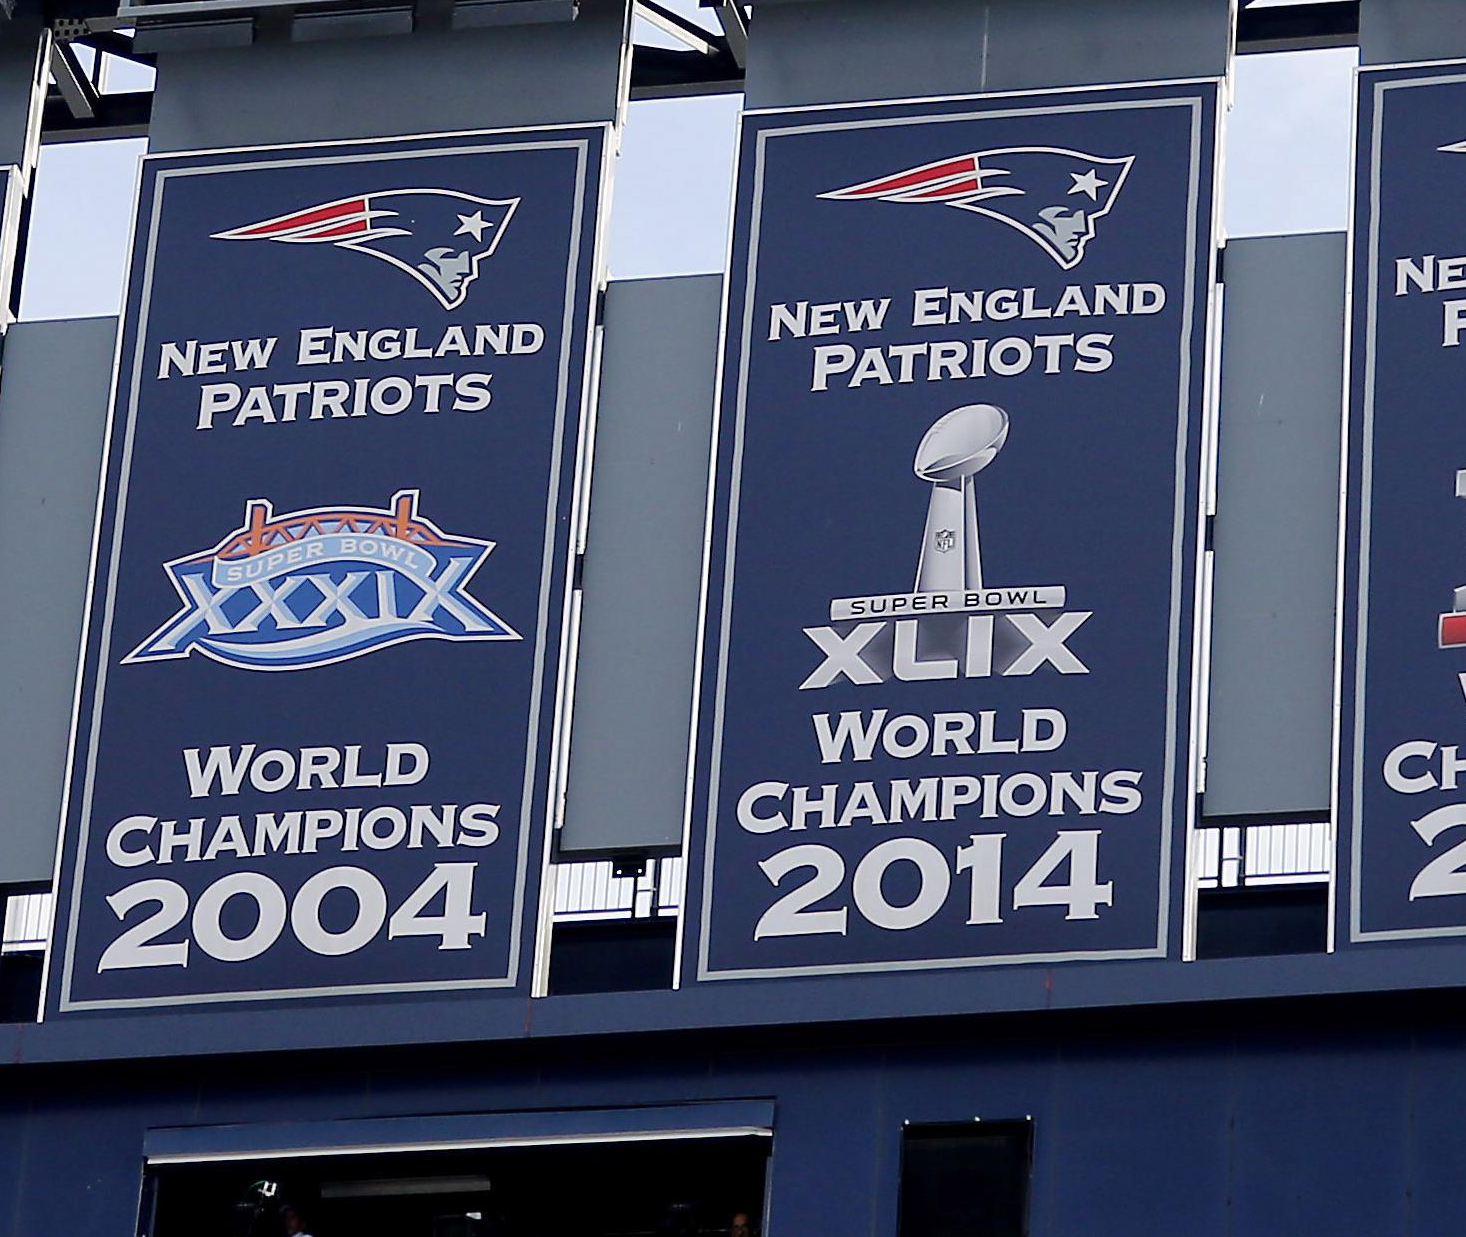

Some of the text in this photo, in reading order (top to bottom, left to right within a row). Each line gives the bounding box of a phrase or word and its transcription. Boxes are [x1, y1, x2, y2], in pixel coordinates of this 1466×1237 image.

[767, 283, 1166, 341] NEW ENGLAND
[157, 323, 545, 380] NEW ENGLAND
[810, 333, 1114, 392] PATRIOTS
[195, 372, 493, 430] PATRIOTS
[226, 538, 420, 581] SUPER BOWL
[148, 556, 495, 651] XXXIX
[851, 590, 1047, 615] SUPER BOWL
[798, 611, 1093, 690] XLIX
[812, 708, 1067, 764] WORLD
[183, 743, 429, 798] WORLD
[736, 770, 1143, 834] CHAMPIONS
[106, 803, 501, 867] CHAMPIONS
[753, 829, 1113, 942] 2014
[97, 862, 487, 974] 2004
